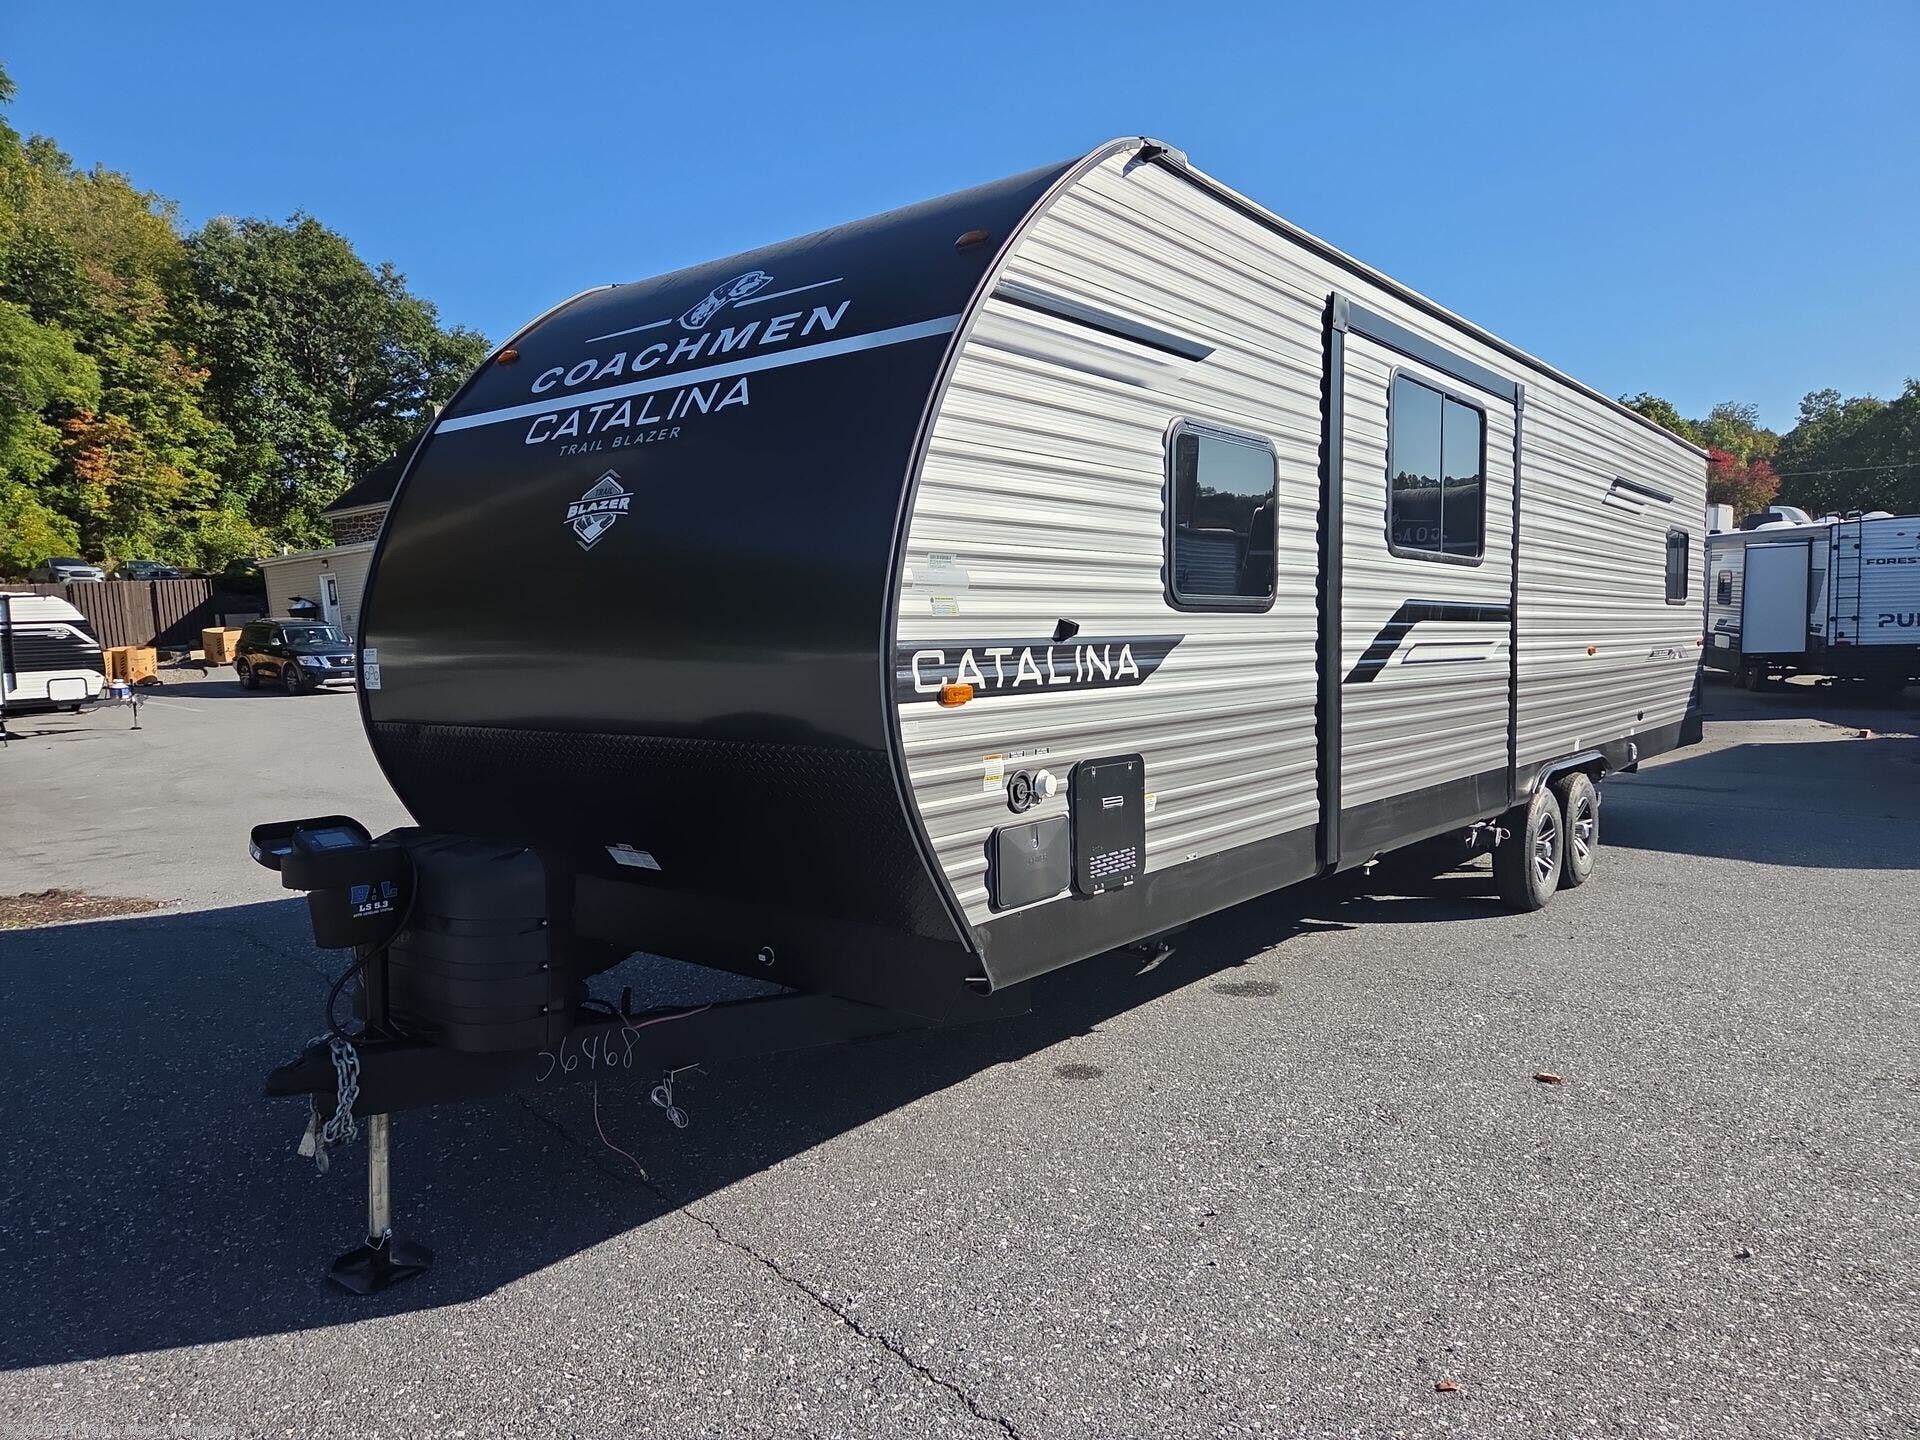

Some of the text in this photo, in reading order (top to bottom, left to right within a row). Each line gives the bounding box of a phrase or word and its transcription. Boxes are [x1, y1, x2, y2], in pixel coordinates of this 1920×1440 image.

[531, 300, 851, 393] COACHMEN
[524, 377, 750, 445] CATALINA
[559, 426, 682, 457] TRAIL BLAZER
[567, 497, 630, 519] BLAZER
[911, 643, 1140, 694] CATALINA
